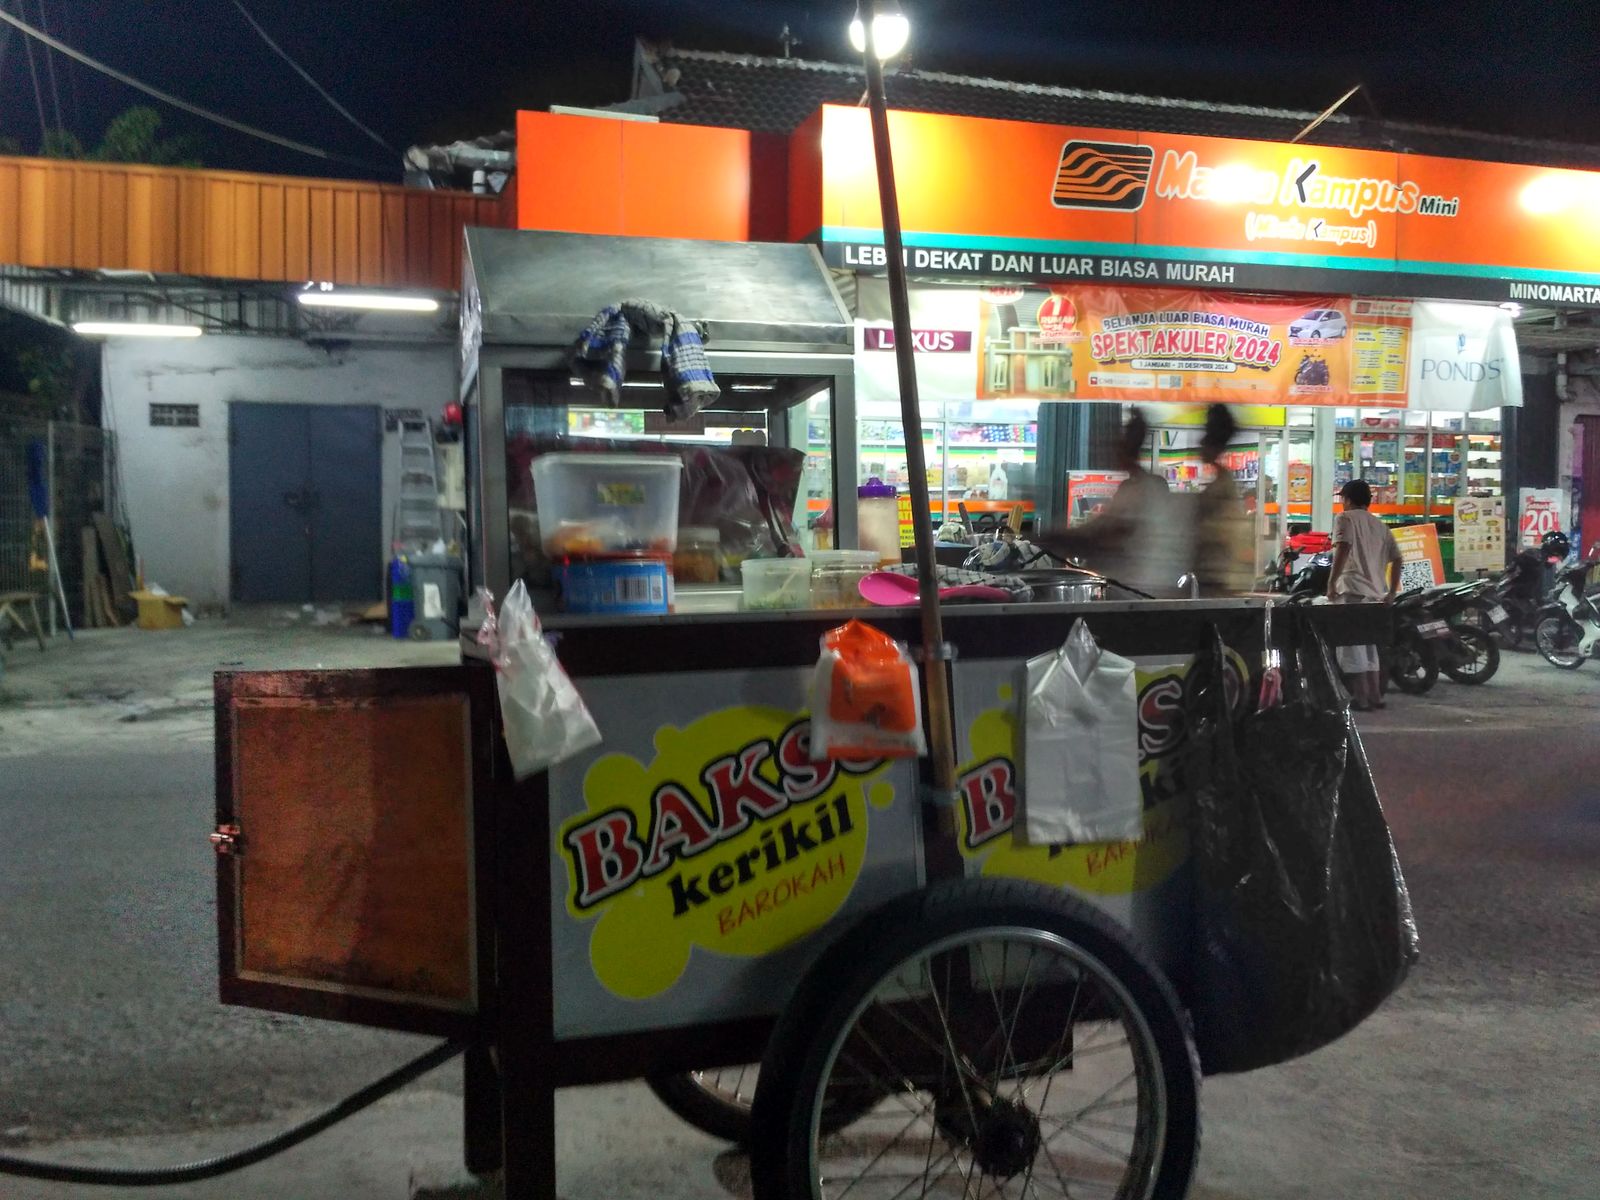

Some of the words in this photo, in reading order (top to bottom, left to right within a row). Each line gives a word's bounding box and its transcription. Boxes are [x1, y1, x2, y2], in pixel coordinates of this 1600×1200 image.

[1281, 158, 1419, 217] Kampus
[1418, 196, 1459, 218] Mini
[845, 245, 908, 267] LEB
[914, 249, 983, 272] DEKAT
[991, 255, 1033, 275] DAN
[1040, 258, 1094, 276] LUAR
[1100, 261, 1159, 280] BIASA
[1166, 264, 1235, 284] MURAH
[879, 330, 954, 353] LXUS
[1103, 312, 1155, 330] BELANJA
[1159, 312, 1189, 324] LUAR
[1193, 313, 1224, 327] BIASA
[1228, 318, 1268, 337] MURAH
[1091, 329, 1228, 360] SPEKTAKULER
[1232, 333, 1282, 366] 2024
[1525, 510, 1553, 536] 20
[668, 794, 853, 918] kerikil
[716, 854, 846, 936] BAROKAH
